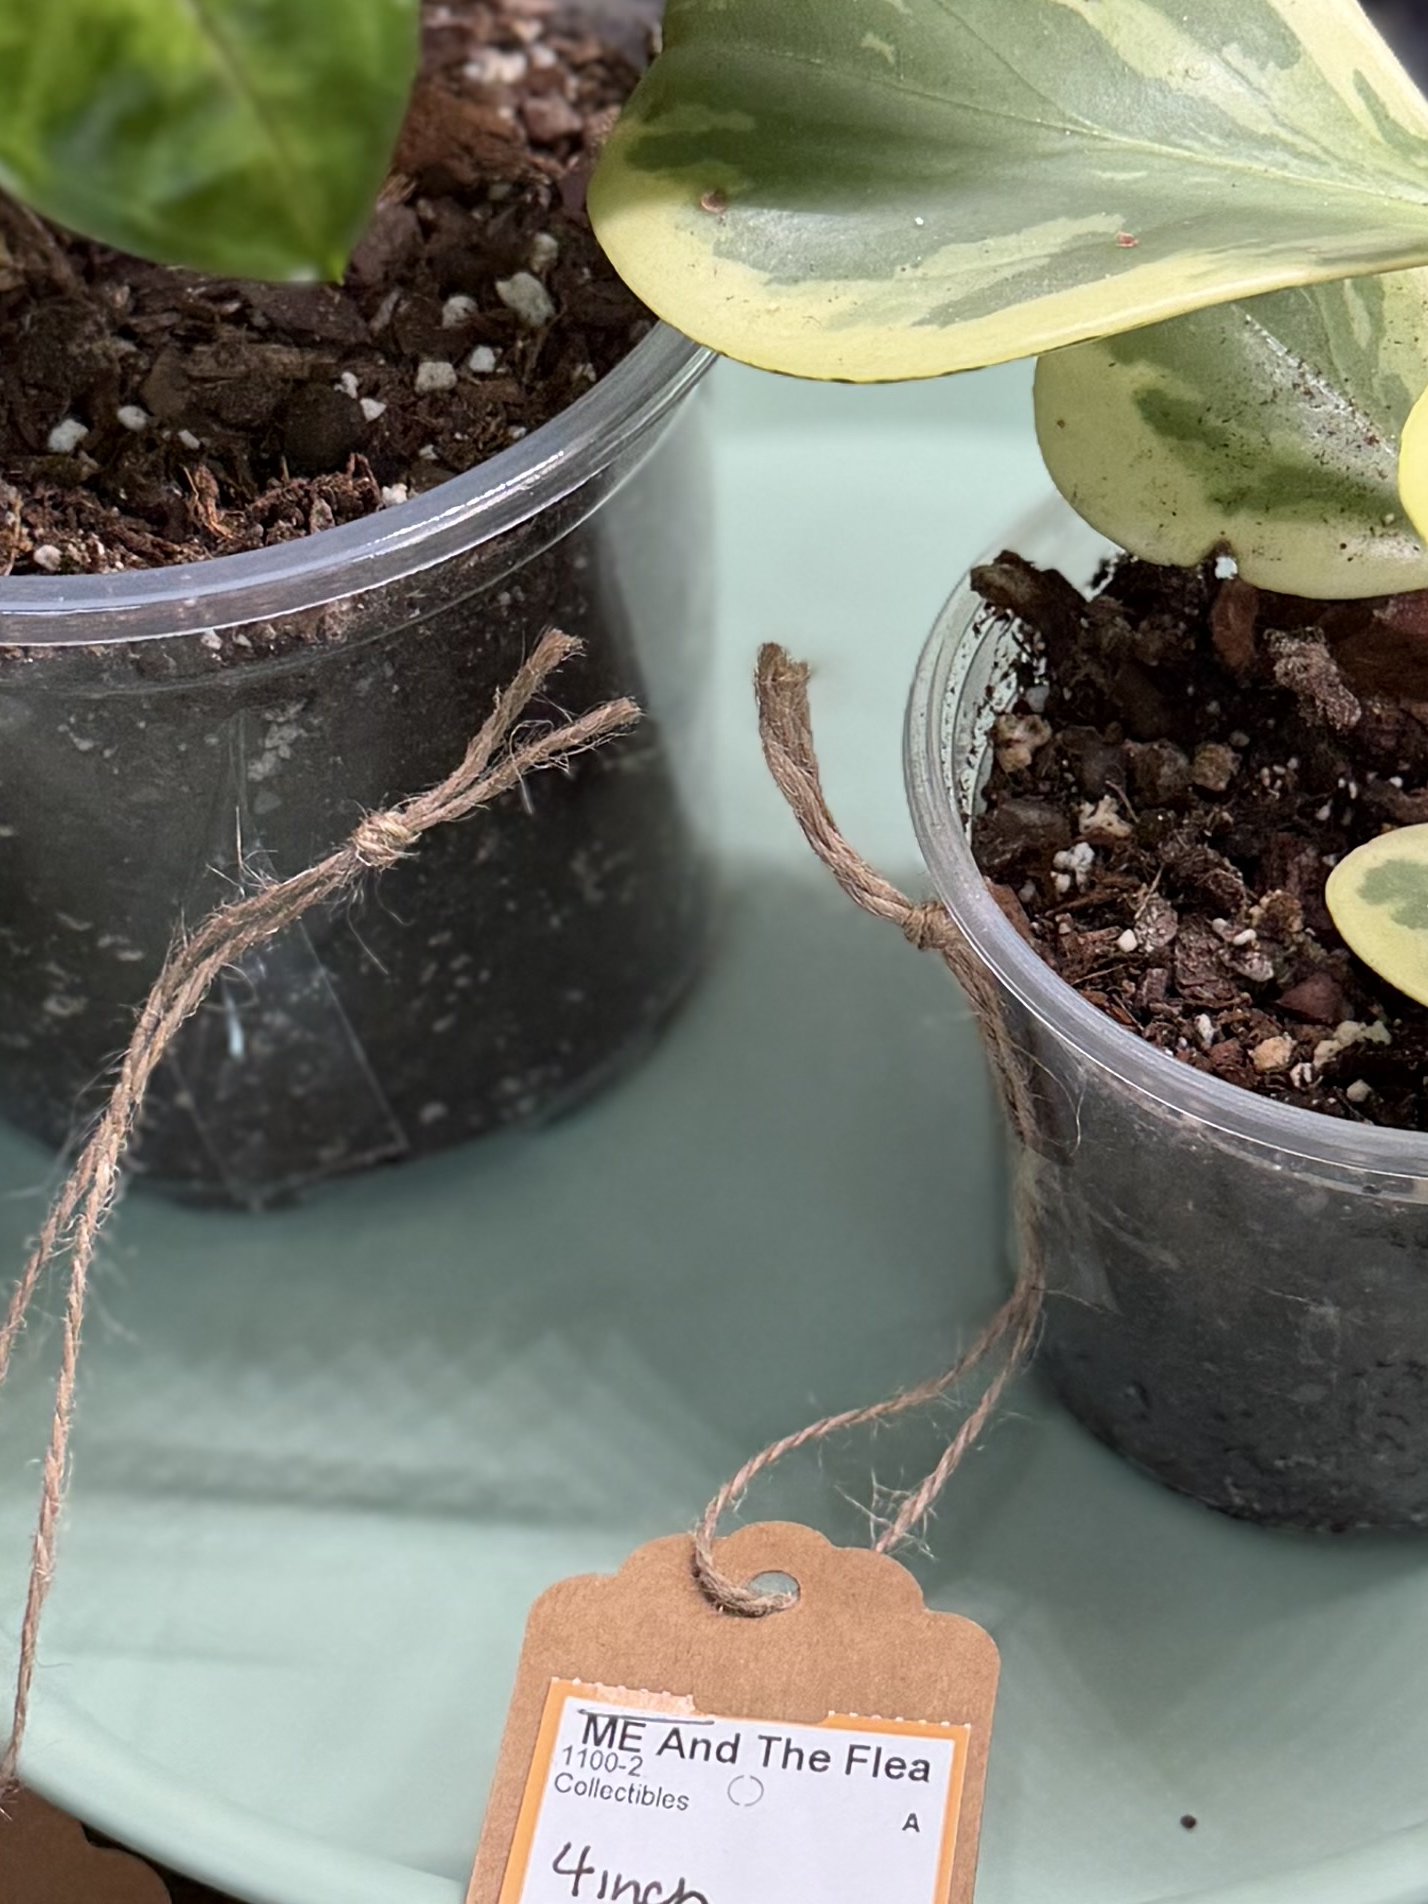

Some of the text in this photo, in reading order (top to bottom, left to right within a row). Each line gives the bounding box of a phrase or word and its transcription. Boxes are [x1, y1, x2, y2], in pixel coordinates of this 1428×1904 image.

[561, 1745, 644, 1779] 1100-2
[581, 1714, 931, 1784] ME And The Flea
[553, 1772, 690, 1812] Collectibles
[901, 1812, 921, 1834] A
